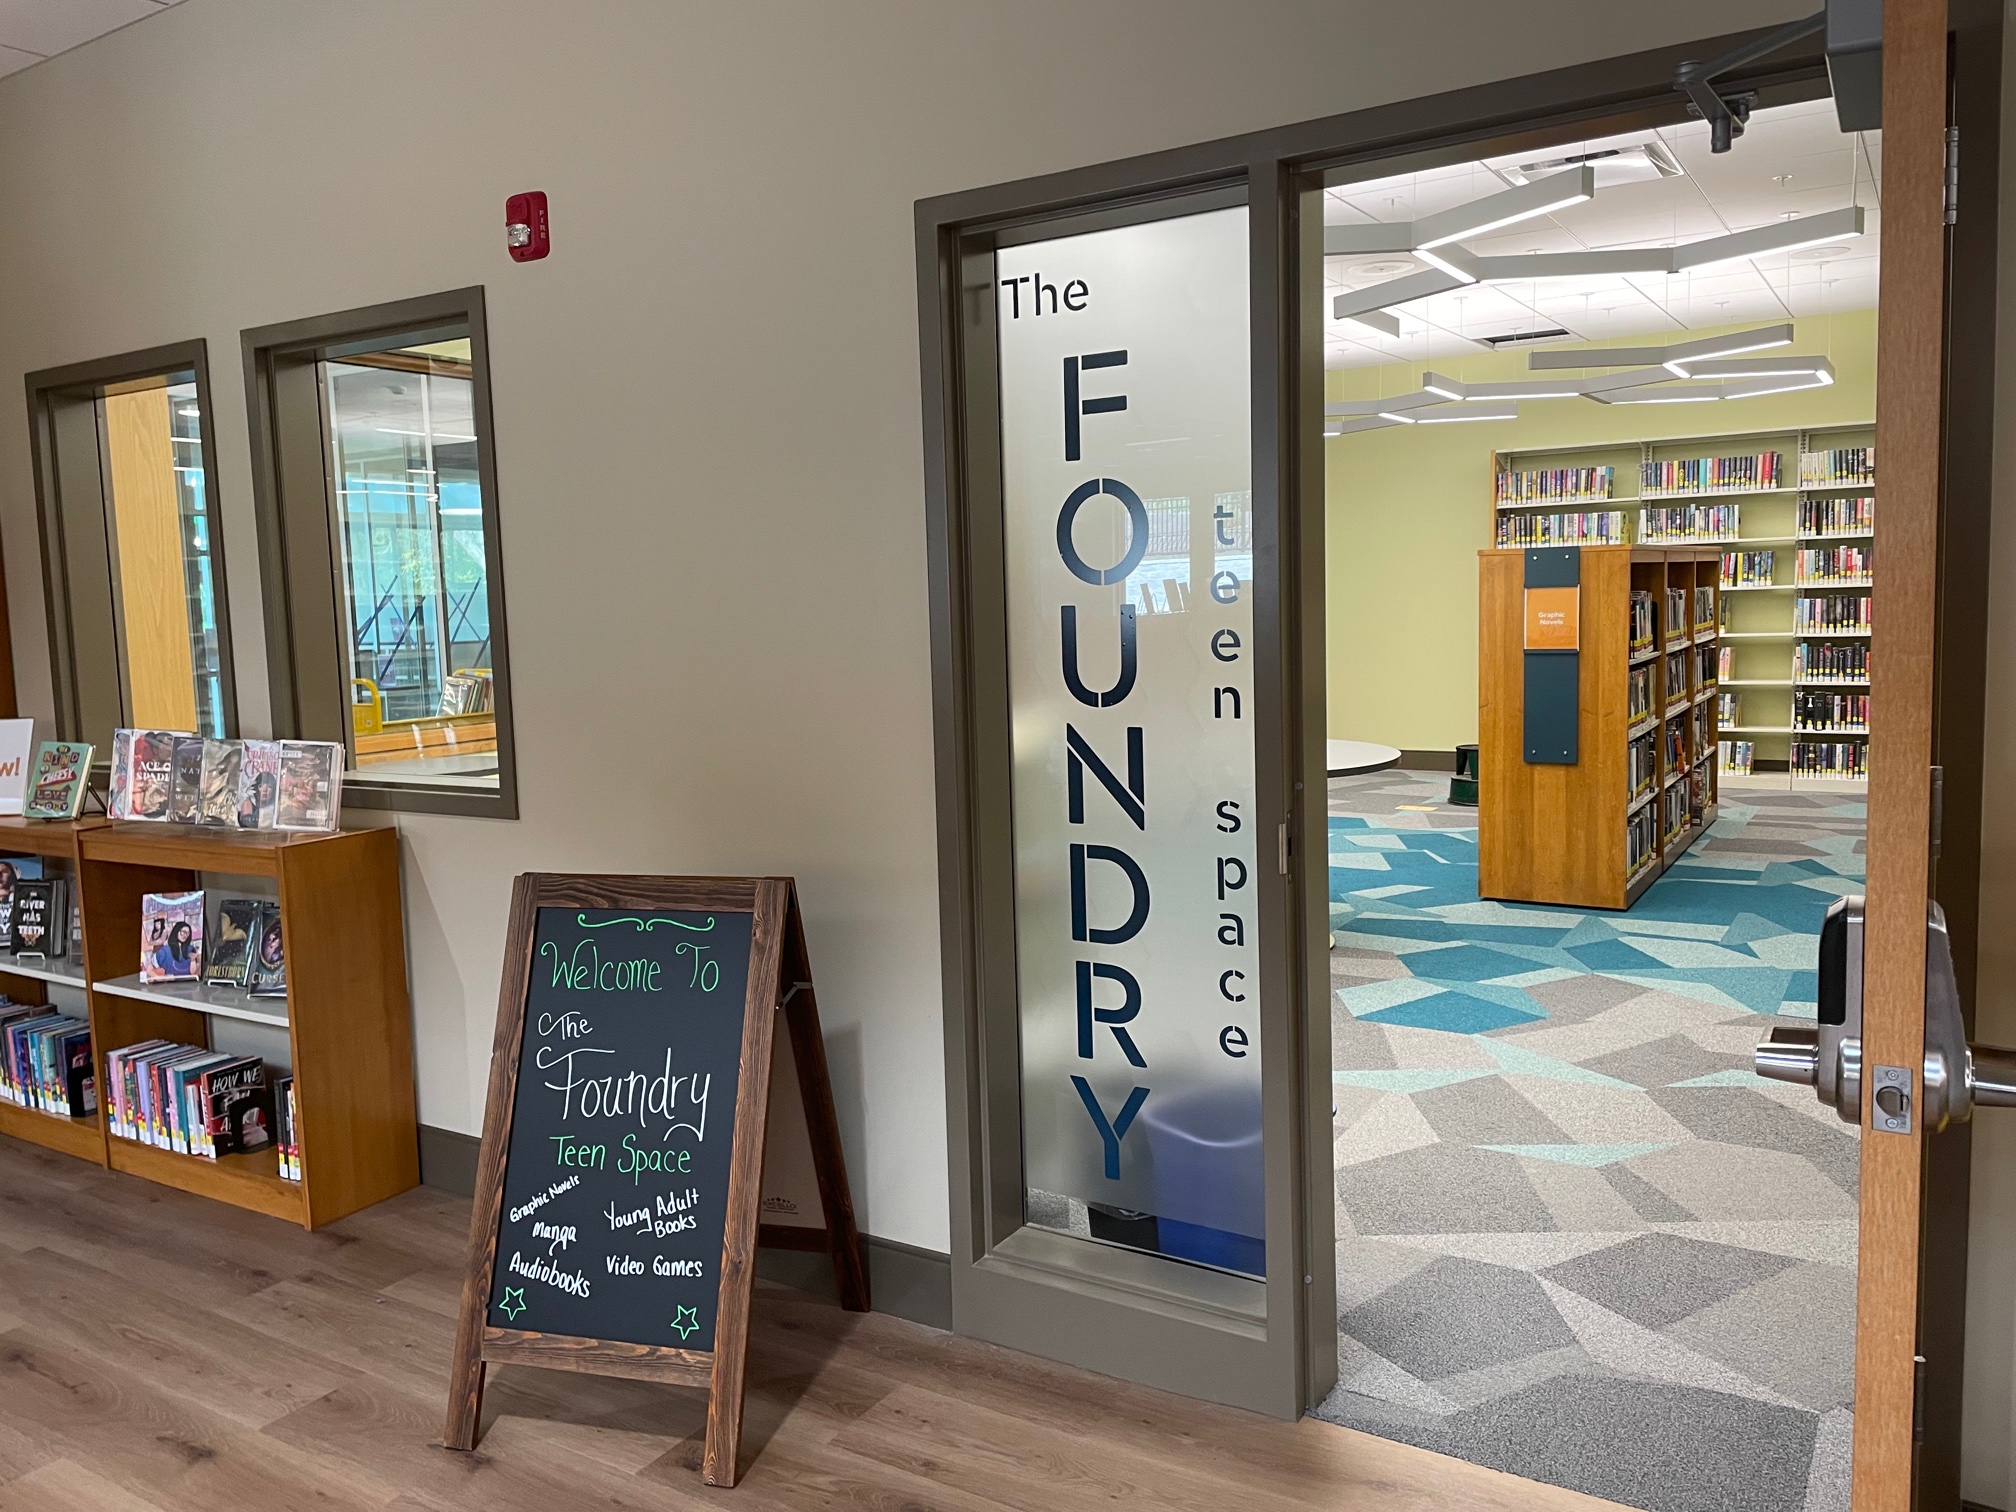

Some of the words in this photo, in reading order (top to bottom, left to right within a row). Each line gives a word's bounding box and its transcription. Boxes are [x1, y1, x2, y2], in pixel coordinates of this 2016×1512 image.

[1001, 273, 1089, 319] The
[1210, 505, 1241, 719] teen
[1538, 611, 1566, 619] Graphic
[39, 766, 75, 784] CHEESY
[138, 761, 161, 771] ACE
[1056, 350, 1151, 1181] FOUNDRY
[36, 790, 67, 800] LOVE
[20, 899, 45, 910] RIVER
[22, 910, 41, 922] HAS
[18, 925, 45, 935] TEETH
[1216, 800, 1249, 1059] space
[541, 939, 663, 992] Welcome
[676, 942, 719, 992] To
[538, 1011, 593, 1040] The
[212, 1071, 239, 1093] HOW
[243, 1065, 261, 1083] WE
[536, 1047, 711, 1142] Foundry
[549, 1135, 606, 1170] Teen
[617, 1133, 691, 1185] Space
[509, 1192, 550, 1223] Graphic
[548, 1175, 580, 1199] Novels
[603, 1200, 653, 1235] Young
[656, 1188, 699, 1217] Adult
[654, 1213, 697, 1238] Books
[508, 1251, 591, 1298] Audiobooks
[606, 1254, 645, 1275] Video
[652, 1254, 703, 1277] Games
